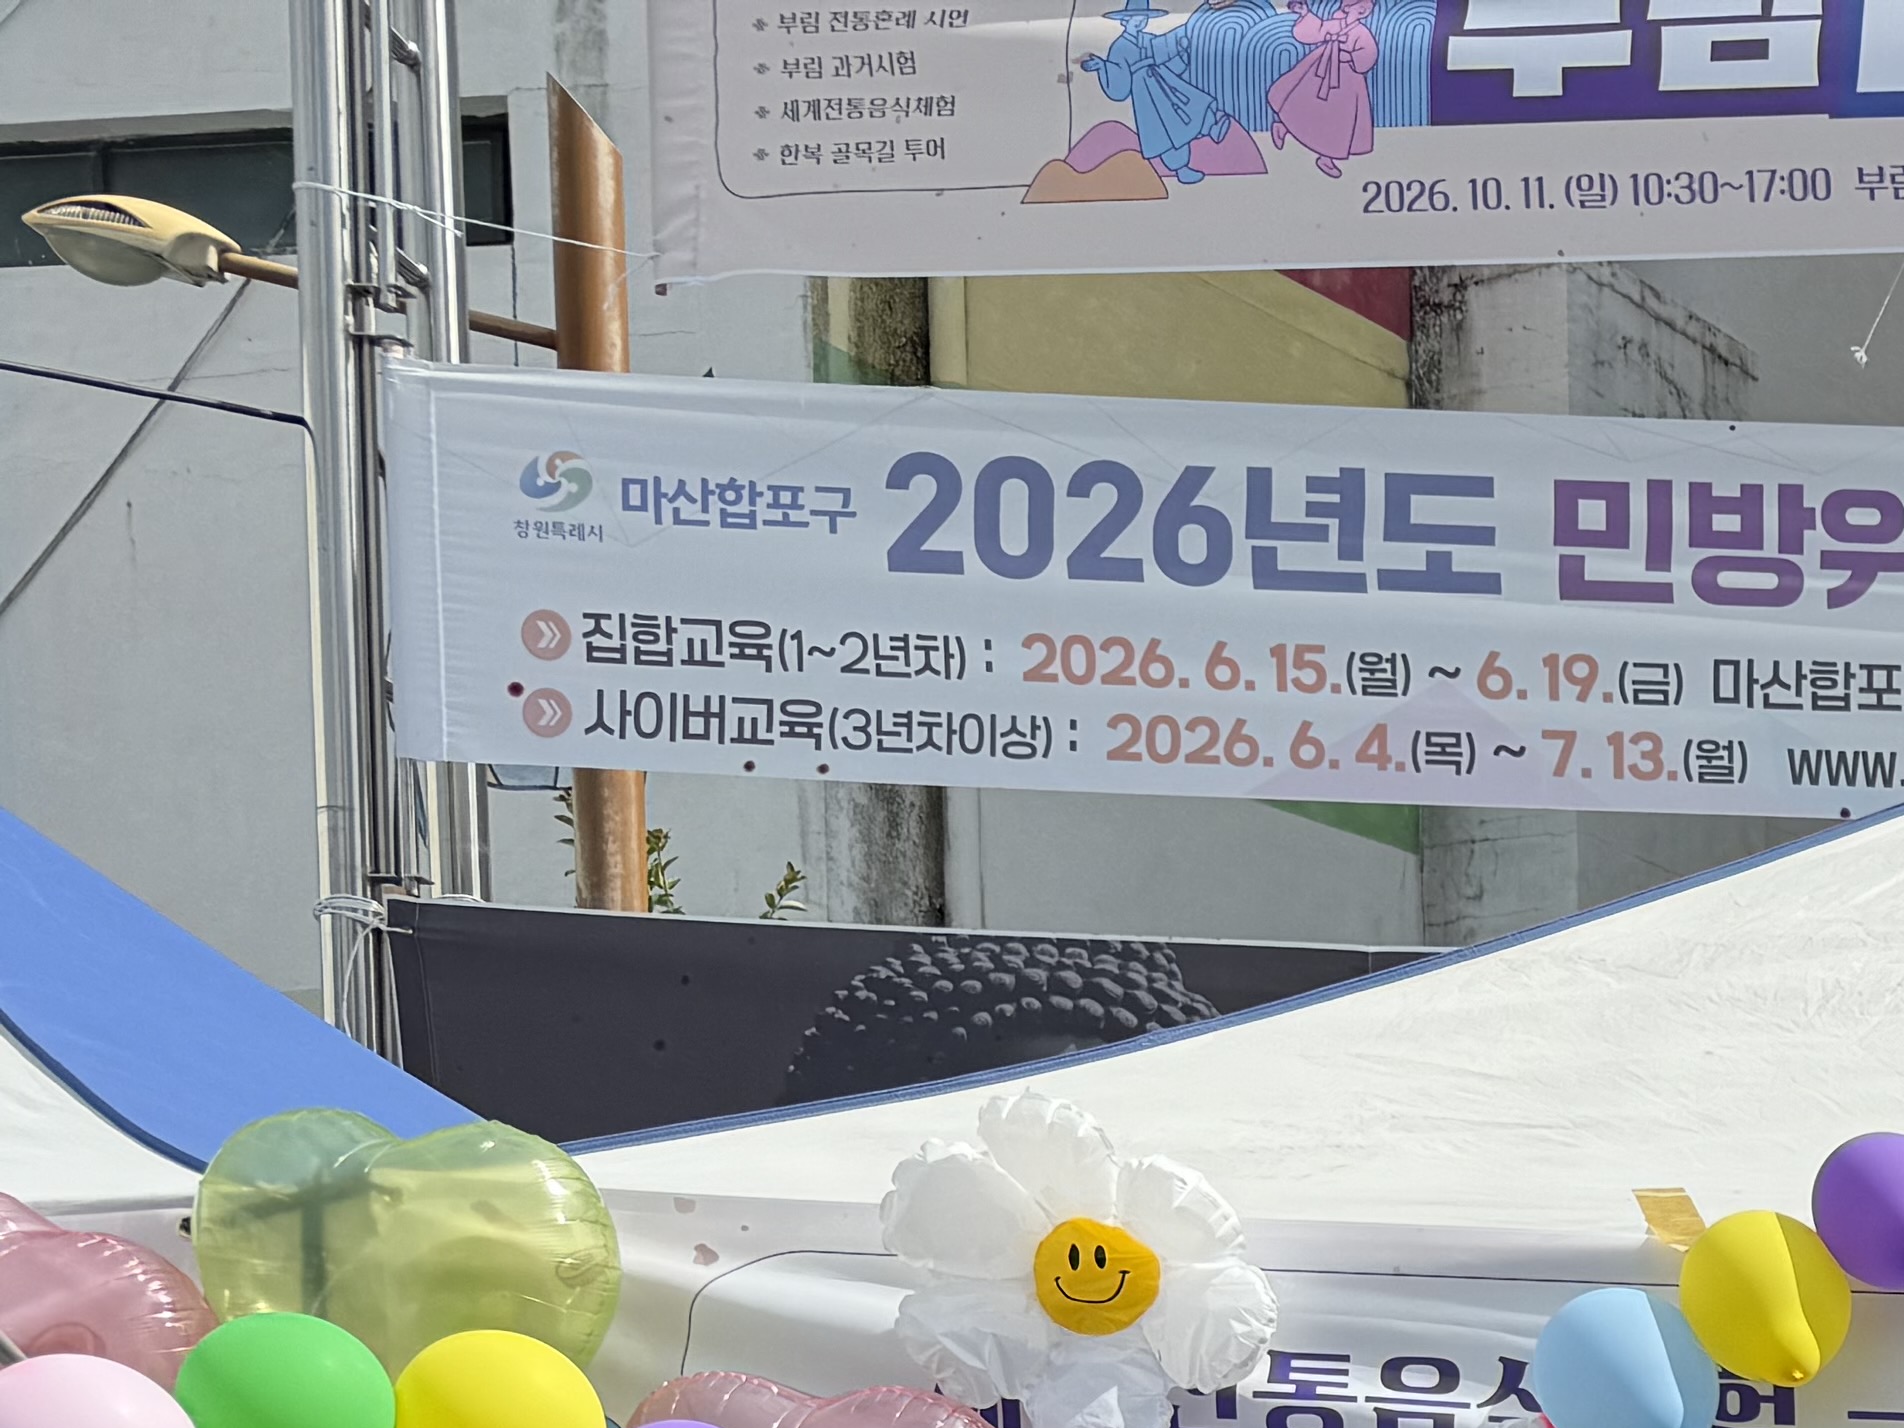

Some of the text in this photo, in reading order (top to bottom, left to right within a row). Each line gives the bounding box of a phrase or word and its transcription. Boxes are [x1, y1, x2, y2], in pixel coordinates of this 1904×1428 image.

[778, 12, 820, 34] 부림
[829, 10, 916, 33] 전통혼례
[781, 51, 916, 79] 부림 과거시험
[781, 95, 955, 122] 세계전통음식체험
[780, 137, 946, 166] 한복 골목길 투어
[1362, 180, 1459, 214] 2026.
[1468, 177, 1510, 211] 10.
[1521, 175, 1555, 209] 11.
[1565, 171, 1619, 209] (일)
[1630, 167, 1832, 207] 10:30~17:00
[513, 515, 606, 544] 창원특례시
[620, 474, 857, 534] 마산합포구
[885, 450, 1502, 596] 2026년도
[581, 610, 967, 681] 집합교육(1~2년차)
[584, 687, 1053, 761] 사이버교육(3년차이상)
